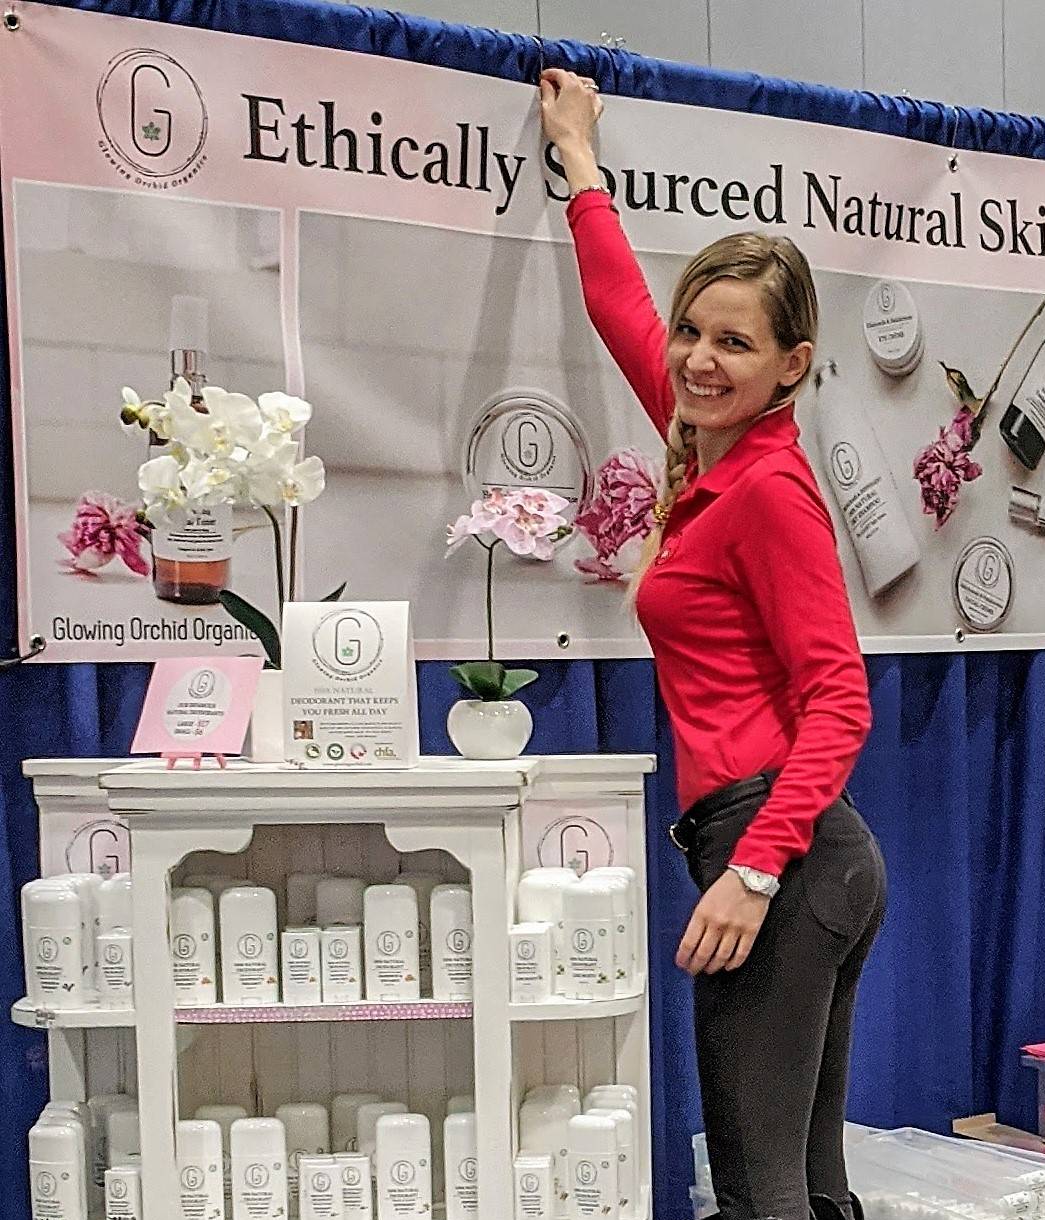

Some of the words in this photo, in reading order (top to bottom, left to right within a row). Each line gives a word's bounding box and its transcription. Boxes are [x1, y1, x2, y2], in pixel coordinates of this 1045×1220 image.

[241, 93, 526, 215] Ethically
[802, 170, 966, 250] Natural
[53, 617, 125, 646] Glowing
[130, 616, 188, 641] Orchid
[302, 708, 321, 716] YOU
